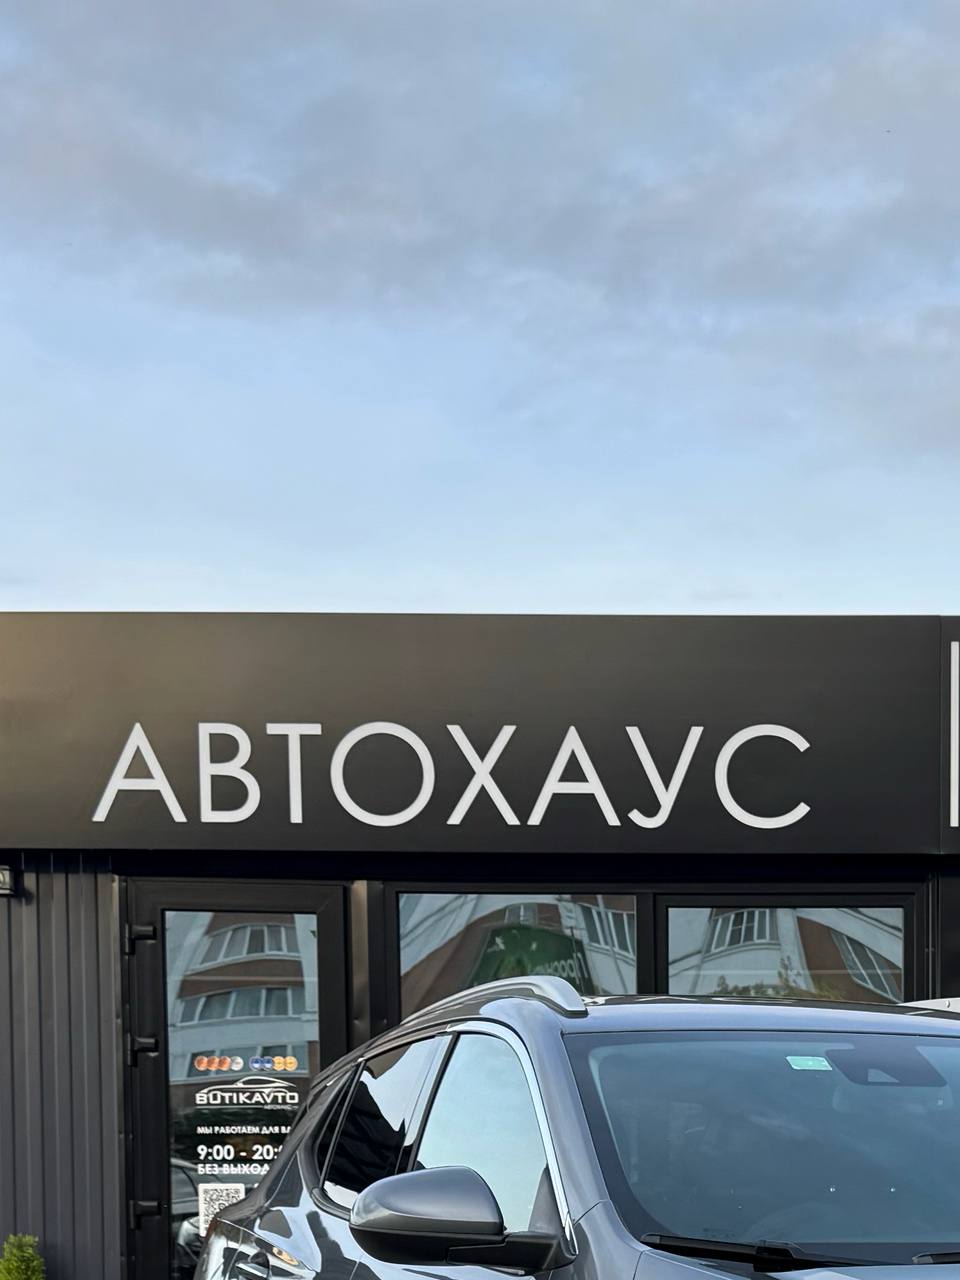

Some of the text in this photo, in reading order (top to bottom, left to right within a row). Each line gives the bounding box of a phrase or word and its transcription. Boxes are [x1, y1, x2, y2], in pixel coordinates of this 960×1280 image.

[92, 722, 811, 830] АВТОХАУС
[195, 1092, 299, 1104] BUTIKAVTO
[196, 1126, 213, 1134] МЫ
[214, 1126, 260, 1134] РАБОТАЕМ
[261, 1126, 279, 1134] ДЛЯ
[196, 1144, 235, 1160] 9:00
[197, 1163, 219, 1174] БЕЗ
